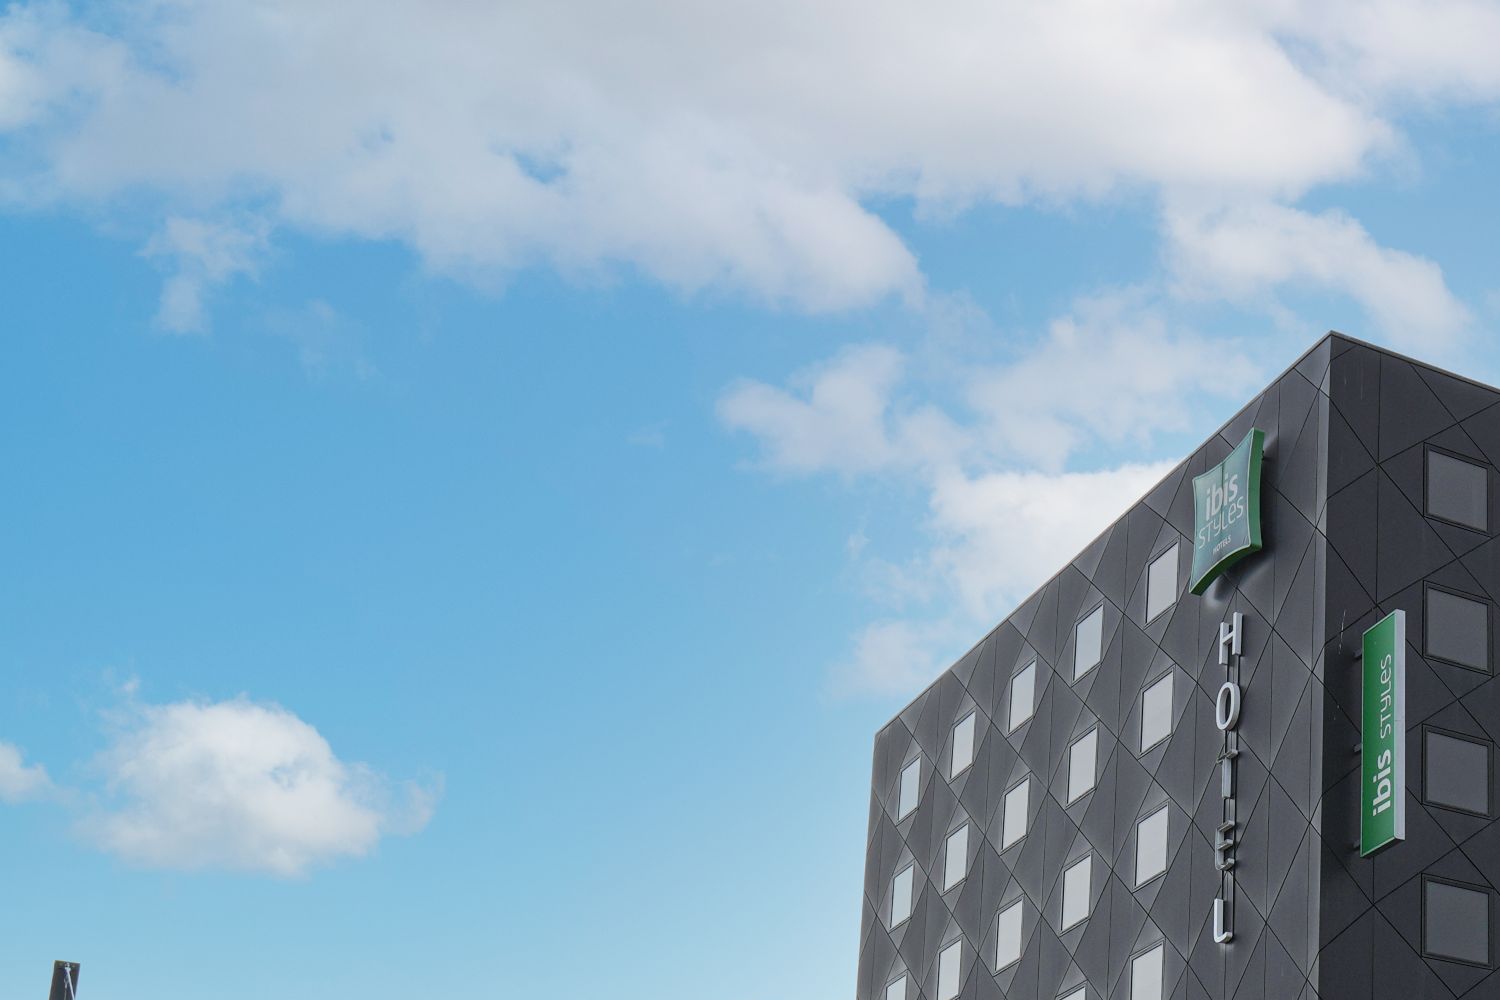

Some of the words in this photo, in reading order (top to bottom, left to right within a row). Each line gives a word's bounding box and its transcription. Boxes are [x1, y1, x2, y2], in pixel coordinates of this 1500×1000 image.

[1205, 471, 1239, 511] ibis
[1211, 534, 1232, 556] HOTELS
[1213, 612, 1244, 945] HOTEL
[1373, 745, 1391, 820] ibis
